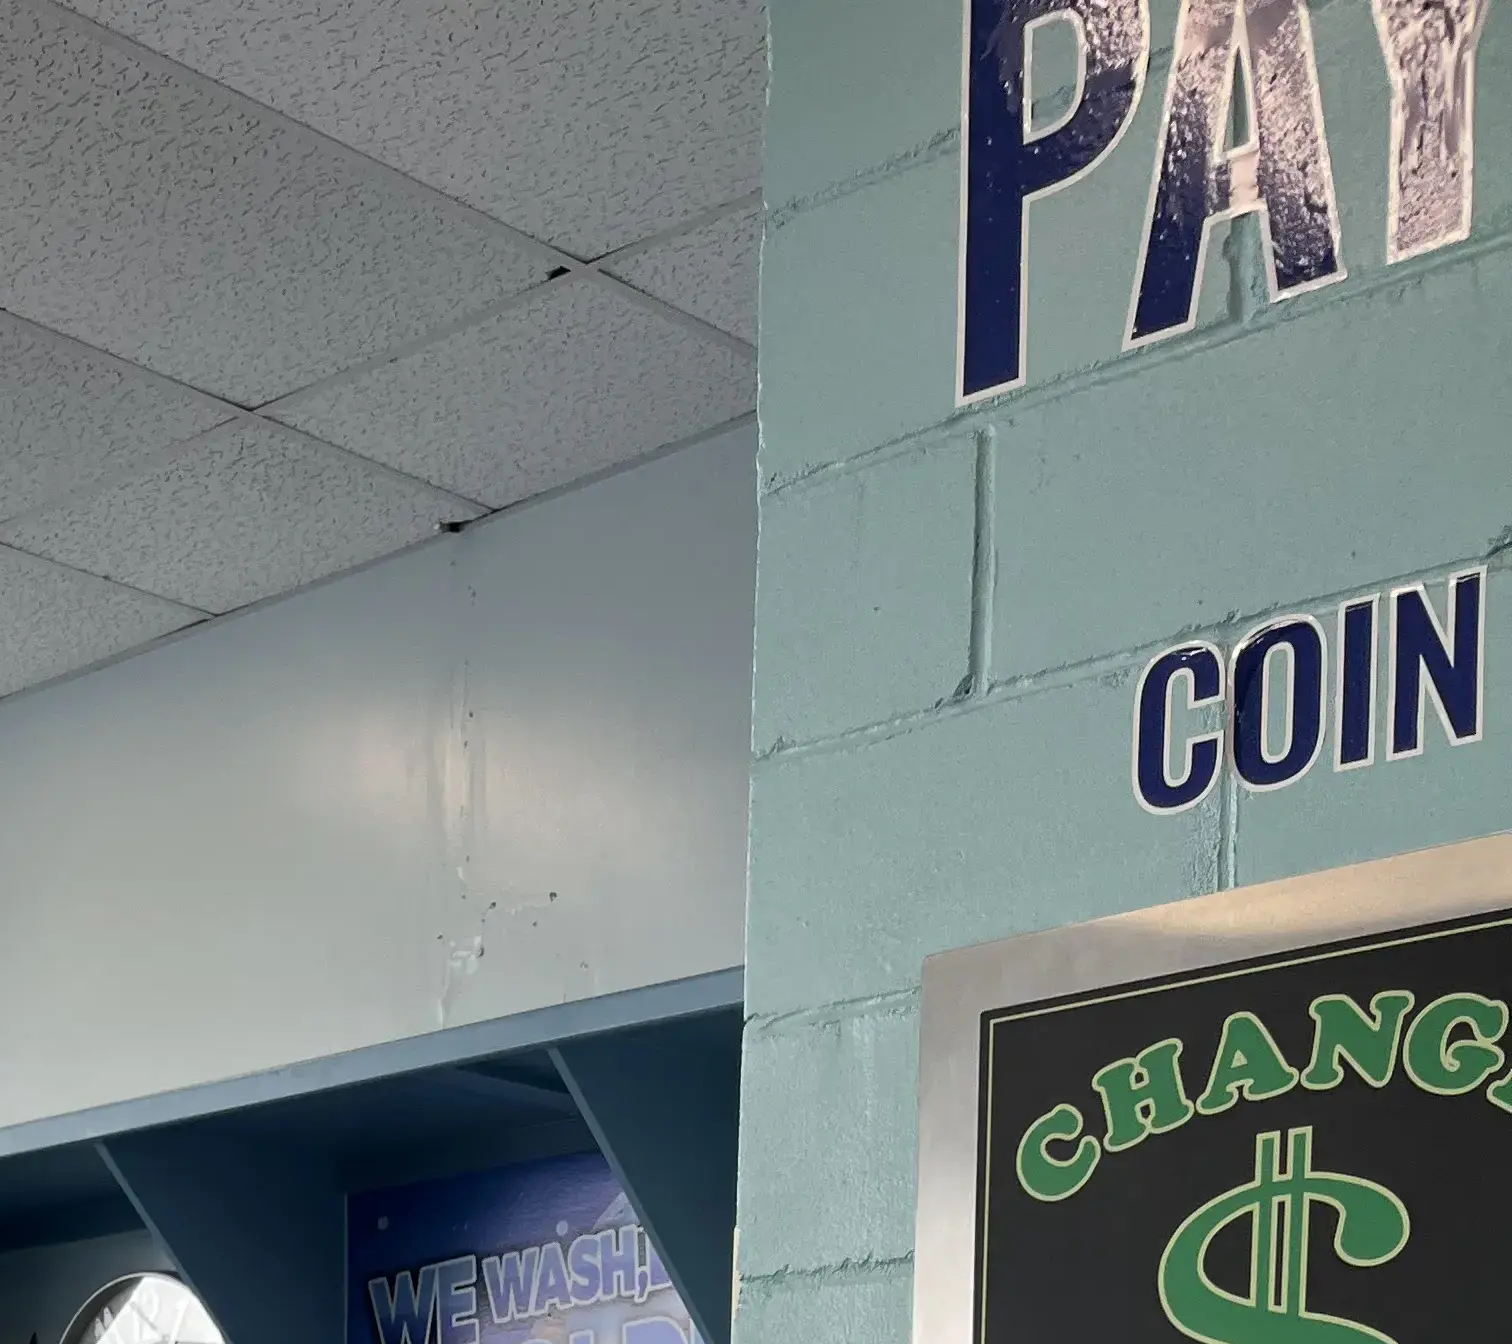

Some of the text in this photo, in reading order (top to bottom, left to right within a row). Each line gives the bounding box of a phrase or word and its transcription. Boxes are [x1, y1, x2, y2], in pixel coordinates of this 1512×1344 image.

[1132, 566, 1488, 816] COIN
[1016, 991, 1512, 1201] CHANG
[481, 1223, 650, 1323] WASH,
